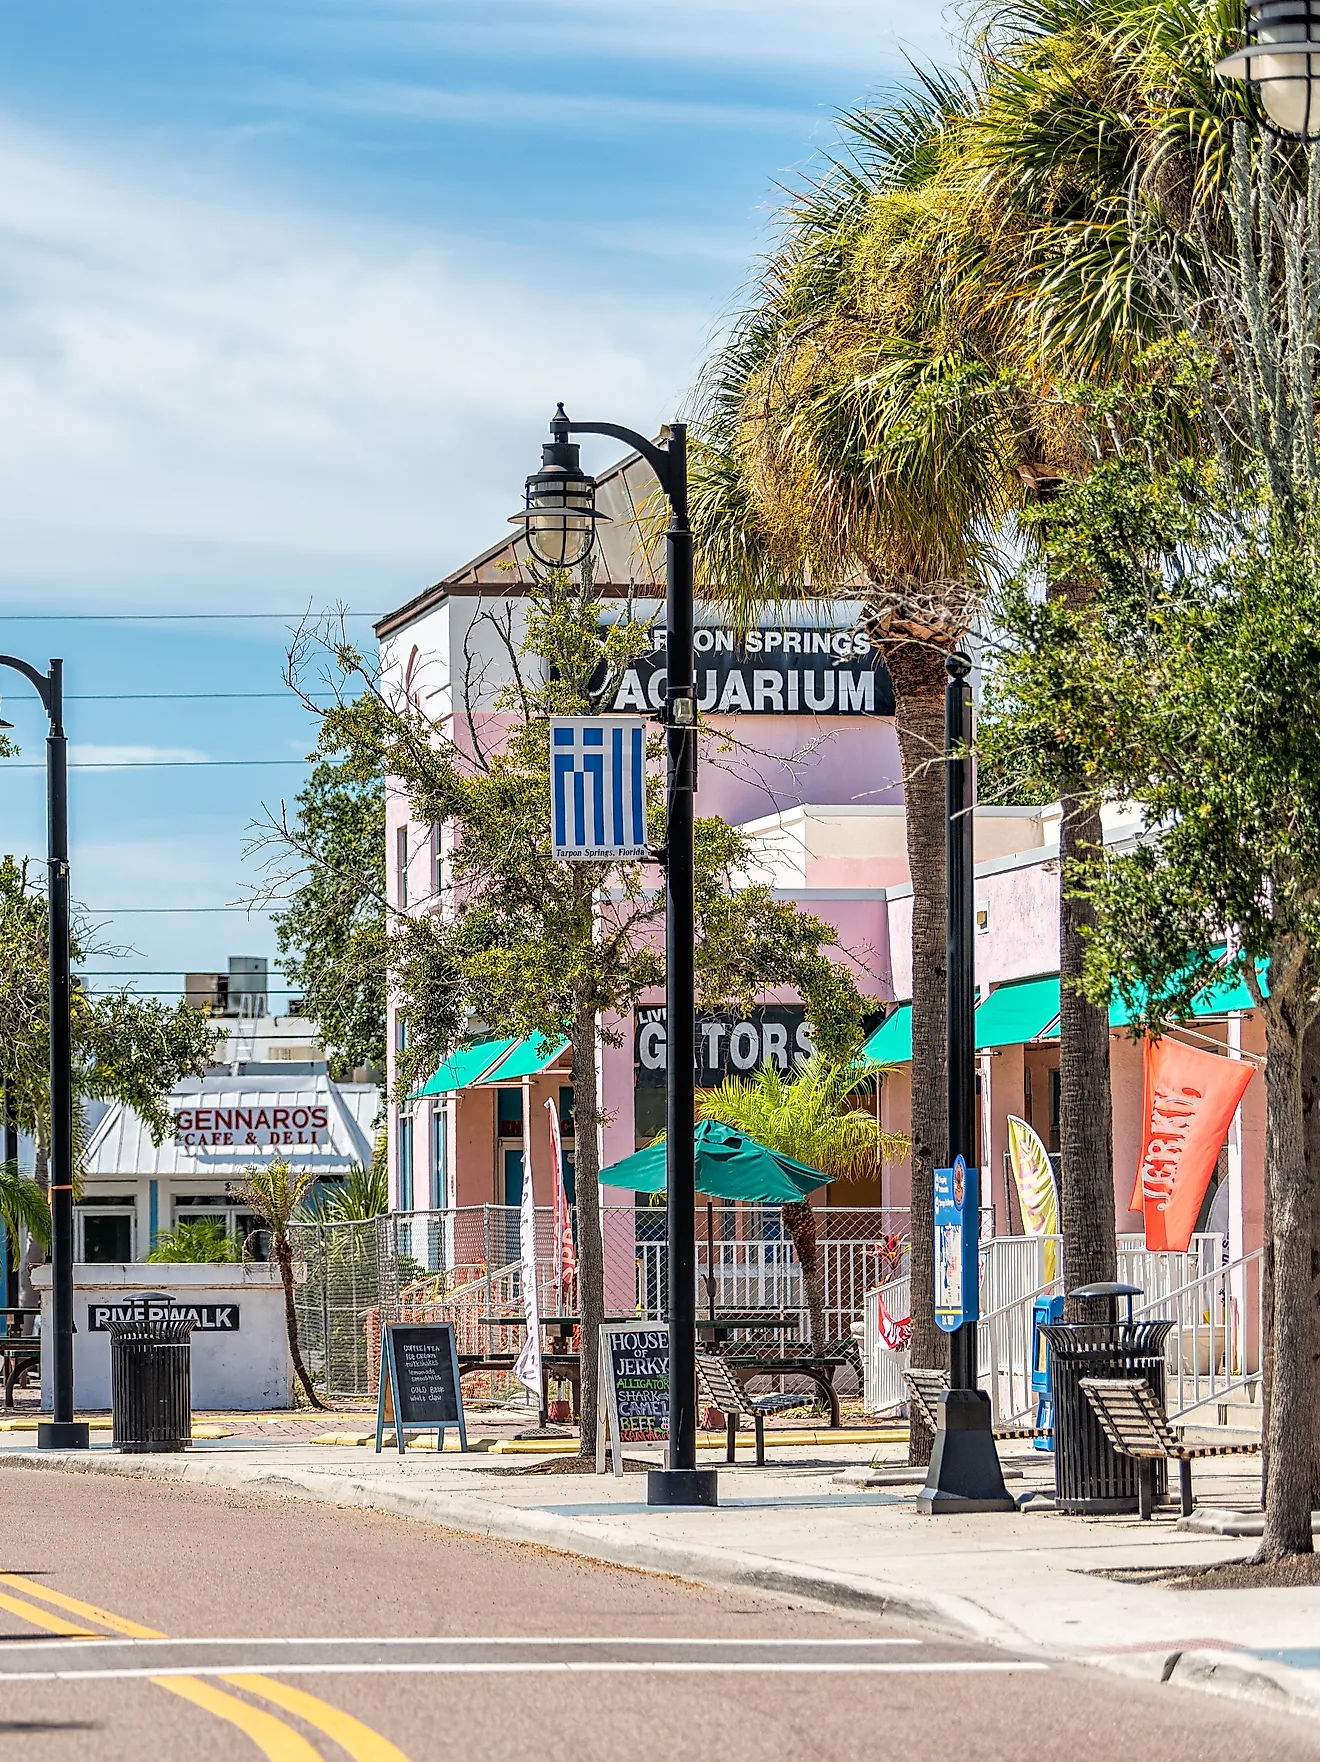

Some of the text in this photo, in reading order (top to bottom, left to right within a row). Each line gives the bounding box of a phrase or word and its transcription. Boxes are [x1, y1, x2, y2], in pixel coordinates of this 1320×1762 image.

[746, 630, 871, 654] SPRINGS
[556, 847, 645, 858] Tarpon Springs, Florida
[639, 1021, 815, 1070] GTORS
[177, 1106, 328, 1131] GENNARO'S
[183, 1131, 318, 1146] CAFE & DELI
[1142, 1088, 1201, 1211] JERKY
[611, 1332, 669, 1350] HOUSE
[634, 1349, 648, 1358] OF
[616, 1357, 669, 1375] JERKY
[616, 1378, 670, 1390] ALLIGATOR
[618, 1390, 659, 1402] SHARK
[618, 1401, 670, 1416] CAMEL
[620, 1415, 656, 1431] BEEF
